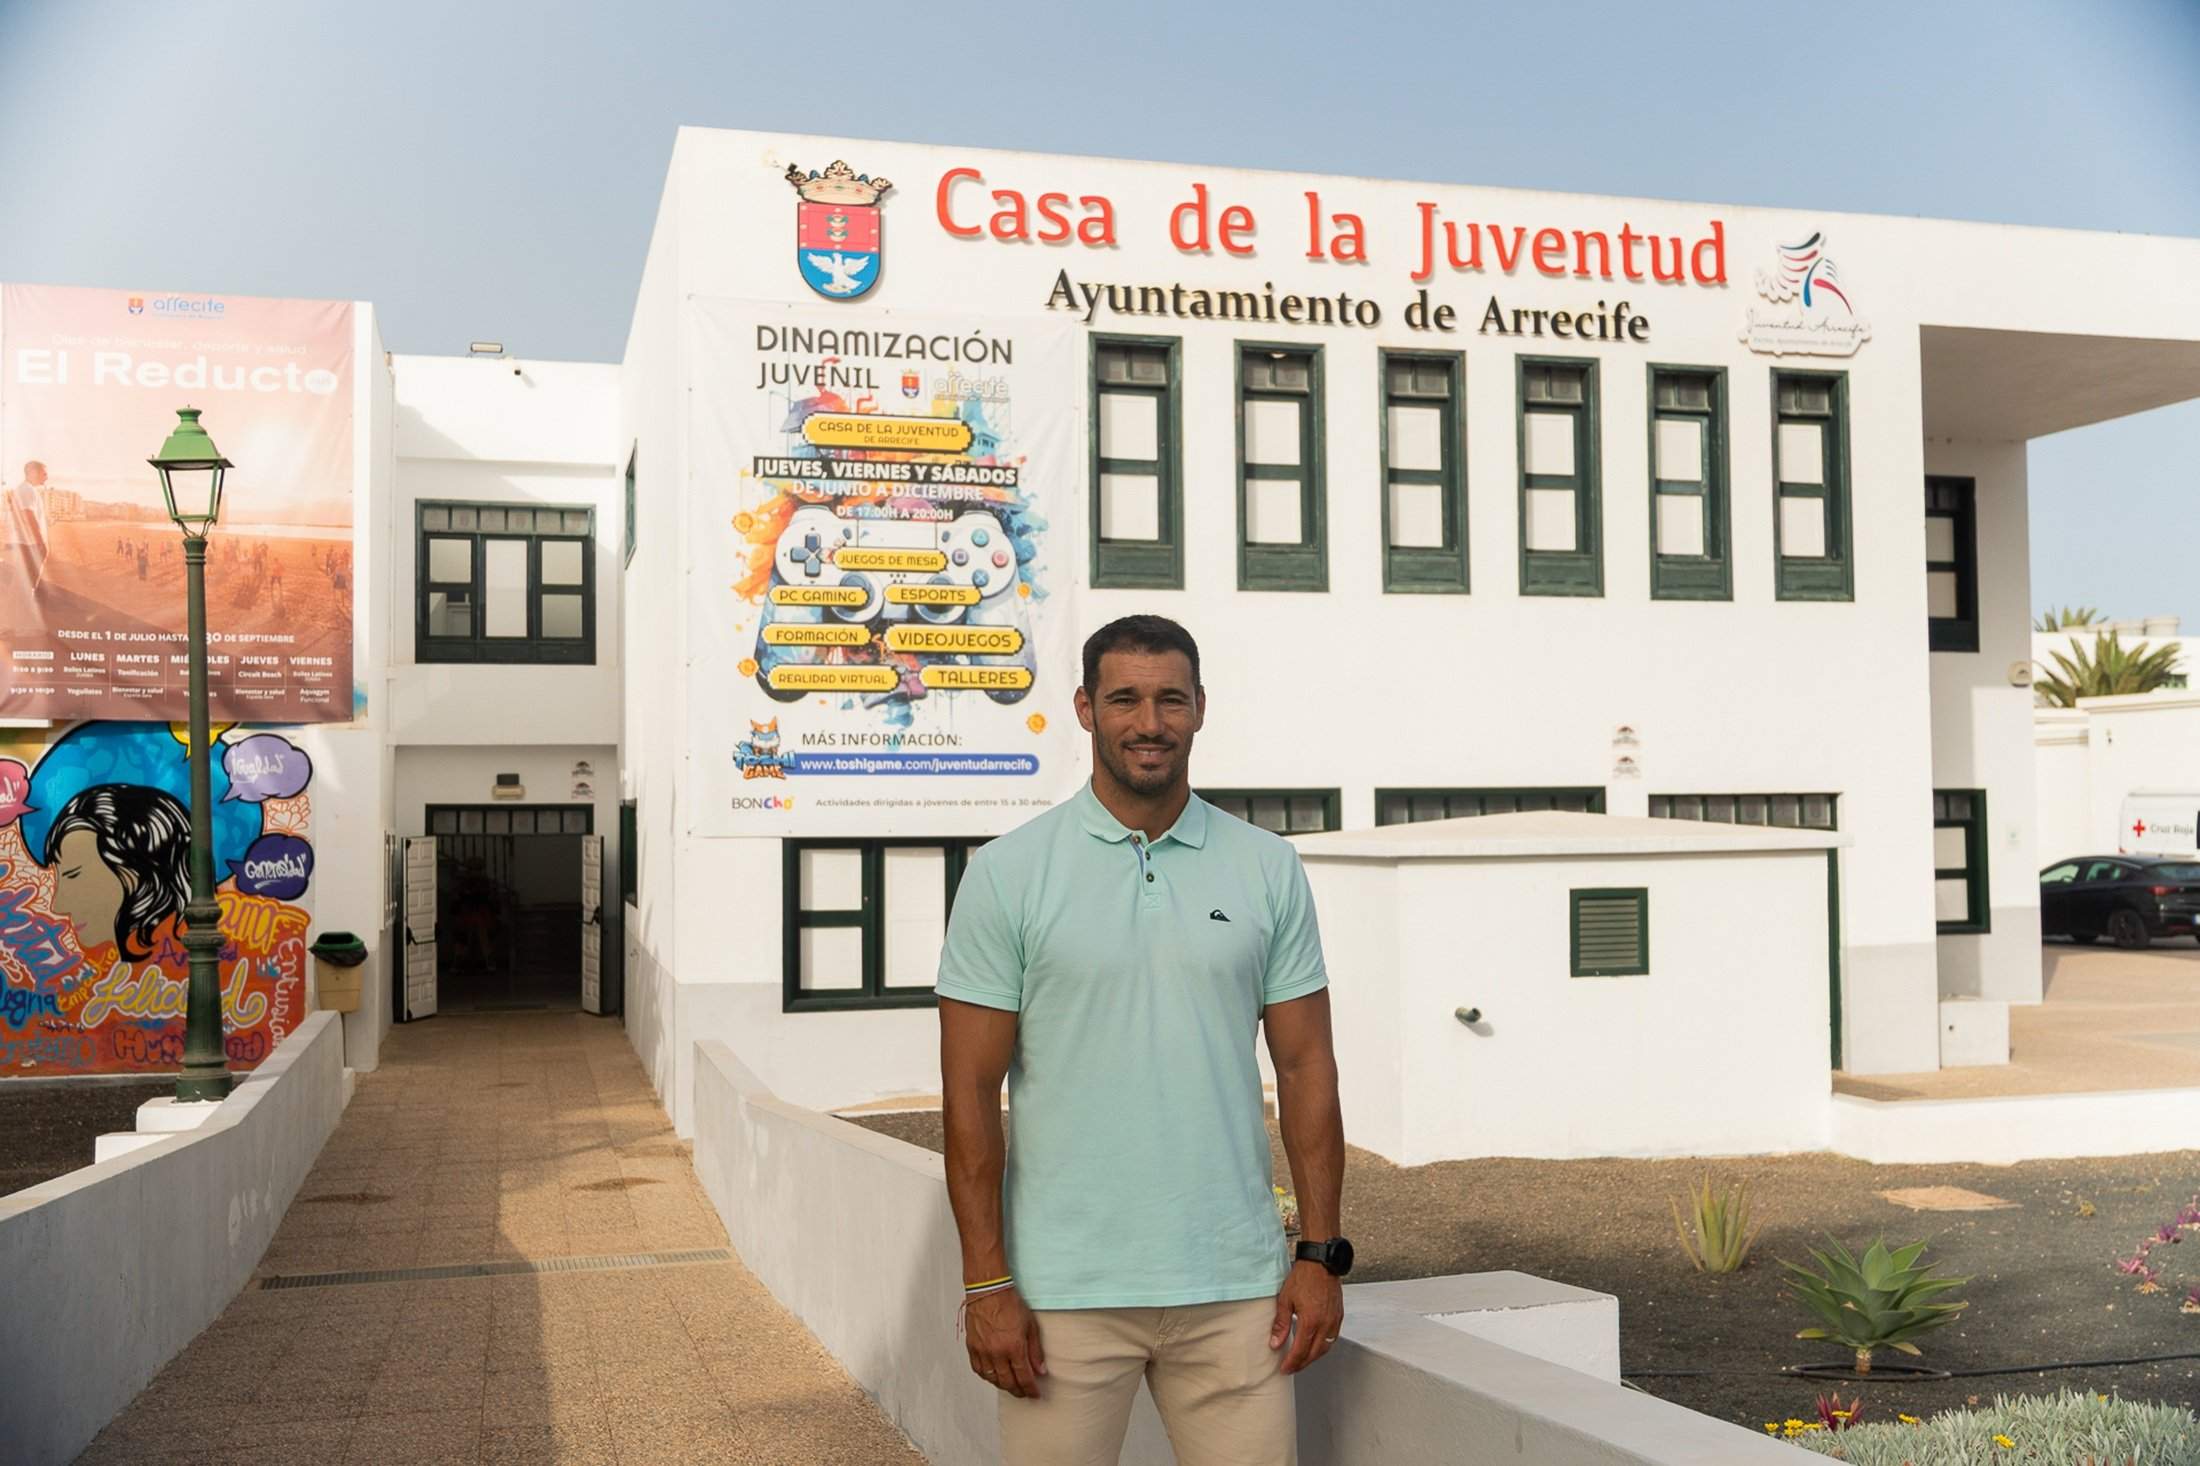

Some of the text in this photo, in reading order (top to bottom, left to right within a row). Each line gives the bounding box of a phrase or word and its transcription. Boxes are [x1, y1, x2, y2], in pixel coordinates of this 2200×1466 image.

[936, 167, 1728, 284] Casa de la Juventud
[1045, 268, 1650, 341] Ayuntamiento de Arrecife
[756, 325, 1013, 364] DINAMIZACIÓN
[16, 348, 339, 394] El Reducto
[756, 362, 880, 390] JUVENIL
[818, 421, 960, 438] CASA DE LA JUVENTUD
[863, 435, 920, 446] DE ARRECIFE
[756, 459, 1017, 485] JUEVES, VIERNES Y SÁBADOS
[793, 480, 984, 501] DE JUNIO A DICIEMBRE
[836, 505, 854, 517] DE
[900, 507, 911, 519] A
[839, 553, 939, 568] JUEGOS DE MESA
[779, 590, 857, 604] PC GAMING
[900, 588, 966, 602] ESPORTS
[57, 629, 189, 643] DESDE EL 1 DE JULIO HASTA
[224, 634, 237, 643] DE
[238, 634, 295, 644] SEPTIEMBRE
[776, 628, 858, 643] FORMACIÓN
[898, 631, 1012, 648] VIDEOJUEGOS
[70, 652, 105, 662] LUNES
[116, 654, 160, 664] MARTES
[240, 655, 280, 665] JUEVES
[289, 656, 333, 666] VIERNES
[778, 672, 888, 685] REALIDAD VIRTUAL
[937, 670, 1018, 685] TALLERES
[802, 729, 963, 747] MÁS INFORMACIÓN:
[800, 757, 1033, 773] www.toshigame.com/juventudarrecife
[815, 798, 870, 808] Actividades
[873, 798, 913, 809] dirigidas
[960, 798, 972, 807] de
[974, 799, 998, 807] entre
